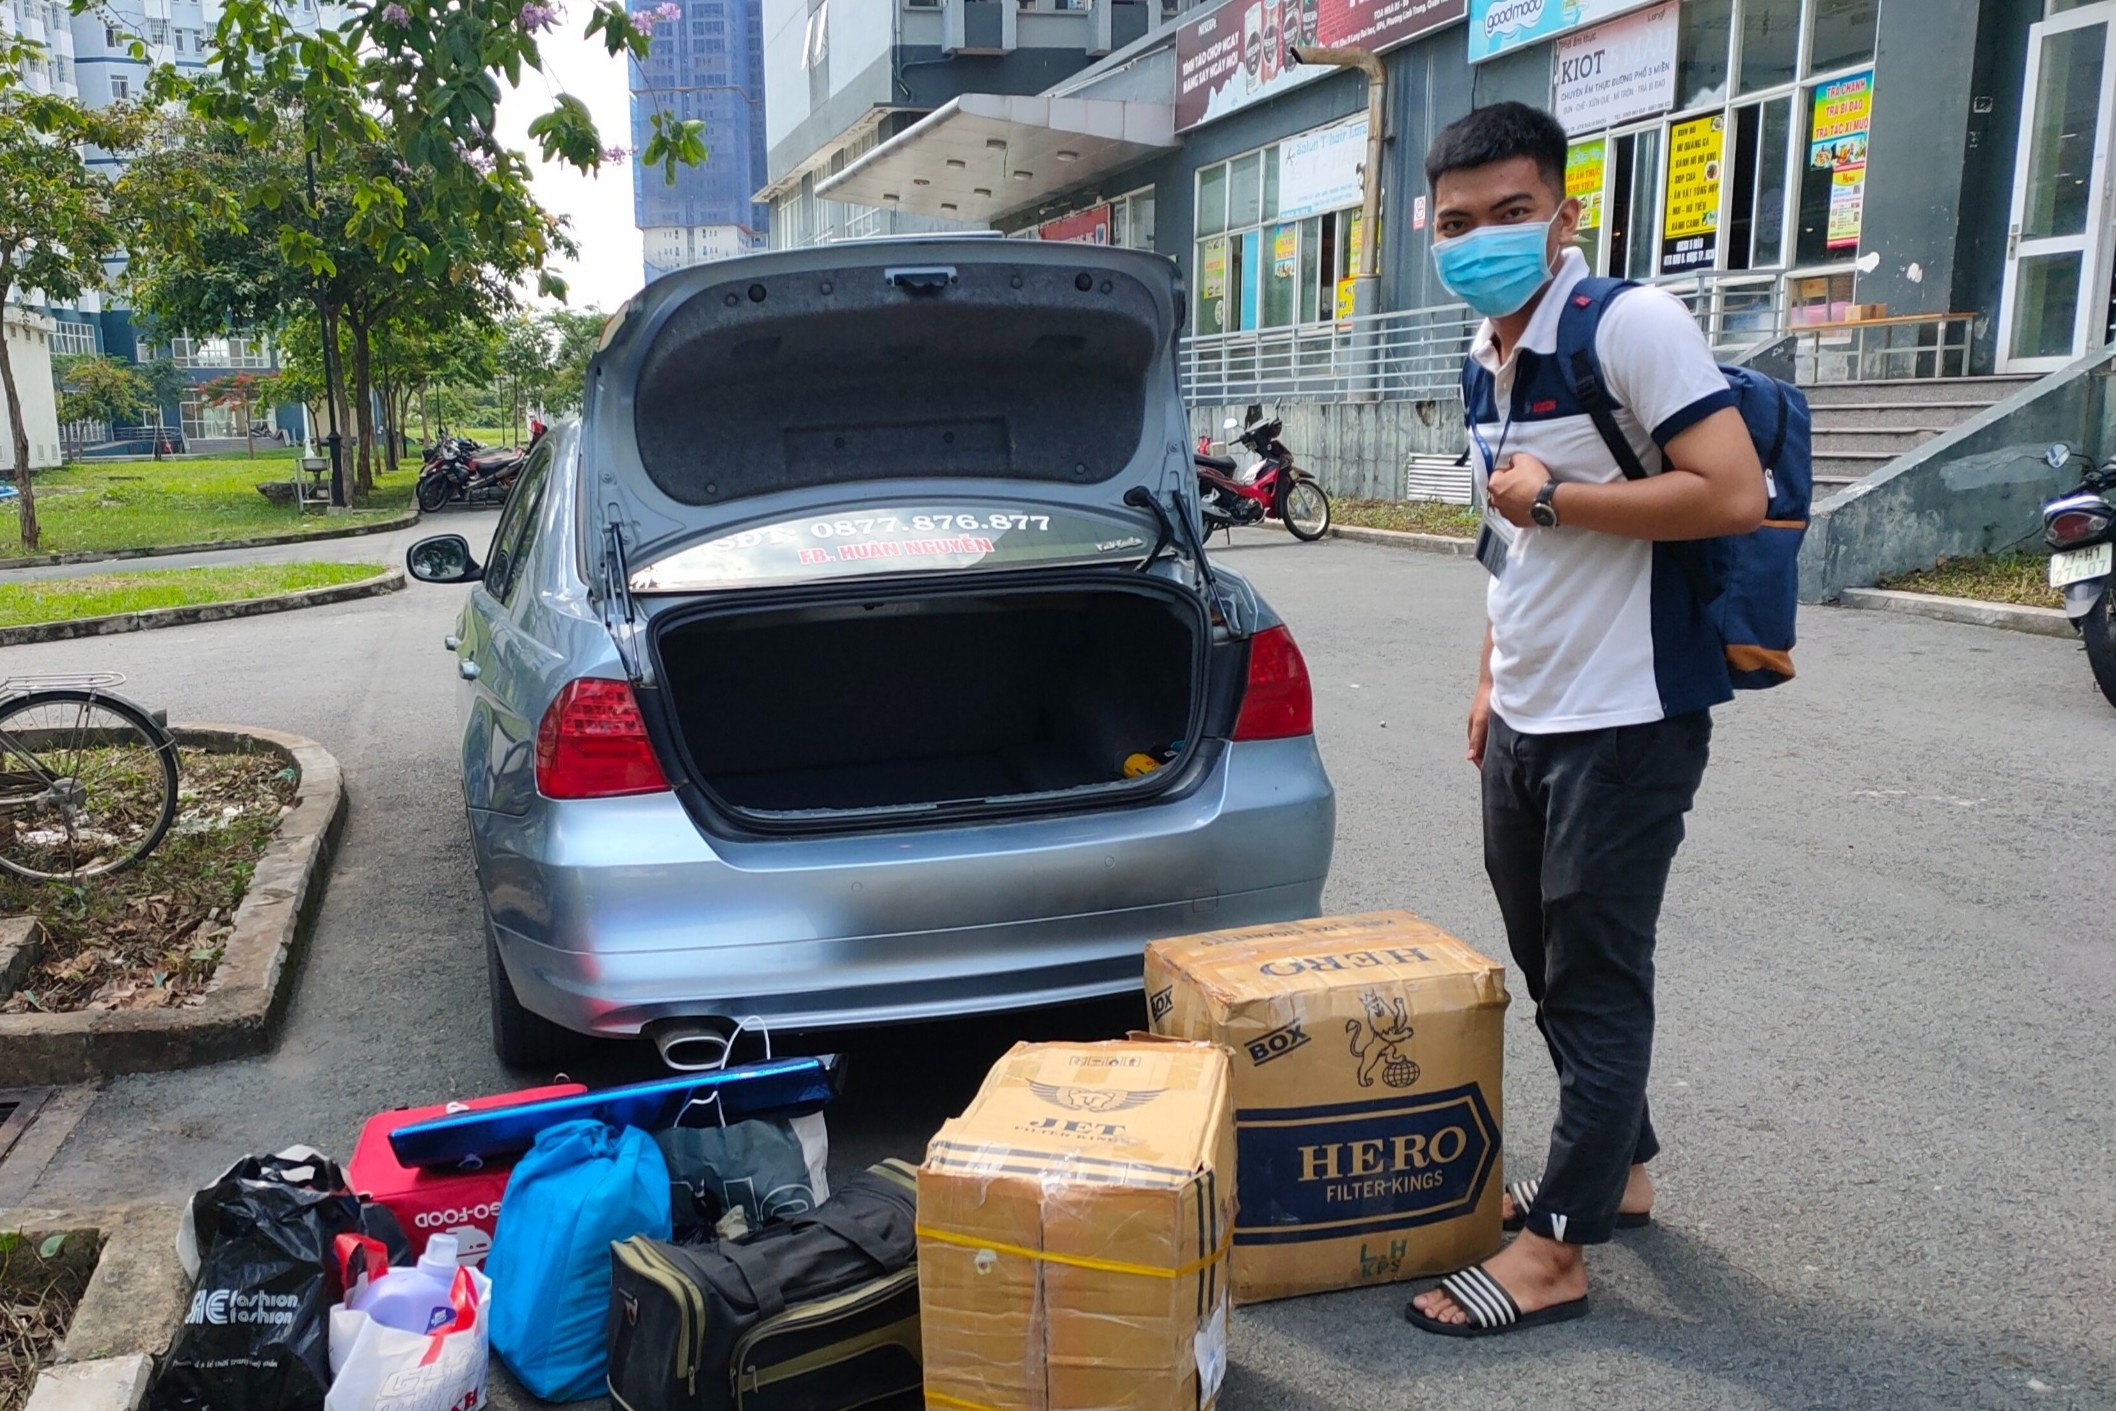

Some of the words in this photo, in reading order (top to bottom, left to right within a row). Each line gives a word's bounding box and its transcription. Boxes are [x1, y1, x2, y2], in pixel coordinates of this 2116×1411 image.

[1561, 48, 1605, 85] KIOT
[1841, 78, 1866, 95] CHANH
[810, 514, 1050, 539] 0877.876.877
[798, 547, 836, 566] FB.
[903, 533, 995, 557] NGUYỄN
[1259, 947, 1437, 977] HERO
[1249, 1024, 1309, 1062] BOX
[1029, 1117, 1126, 1136] JET
[1298, 1126, 1467, 1182] HERO
[1326, 1180, 1385, 1203] FILTER
[1392, 1170, 1443, 1194] KINGS
[414, 1201, 502, 1228] GO-FOOD
[229, 1289, 298, 1308] fashion
[229, 1307, 293, 1325] fashion
